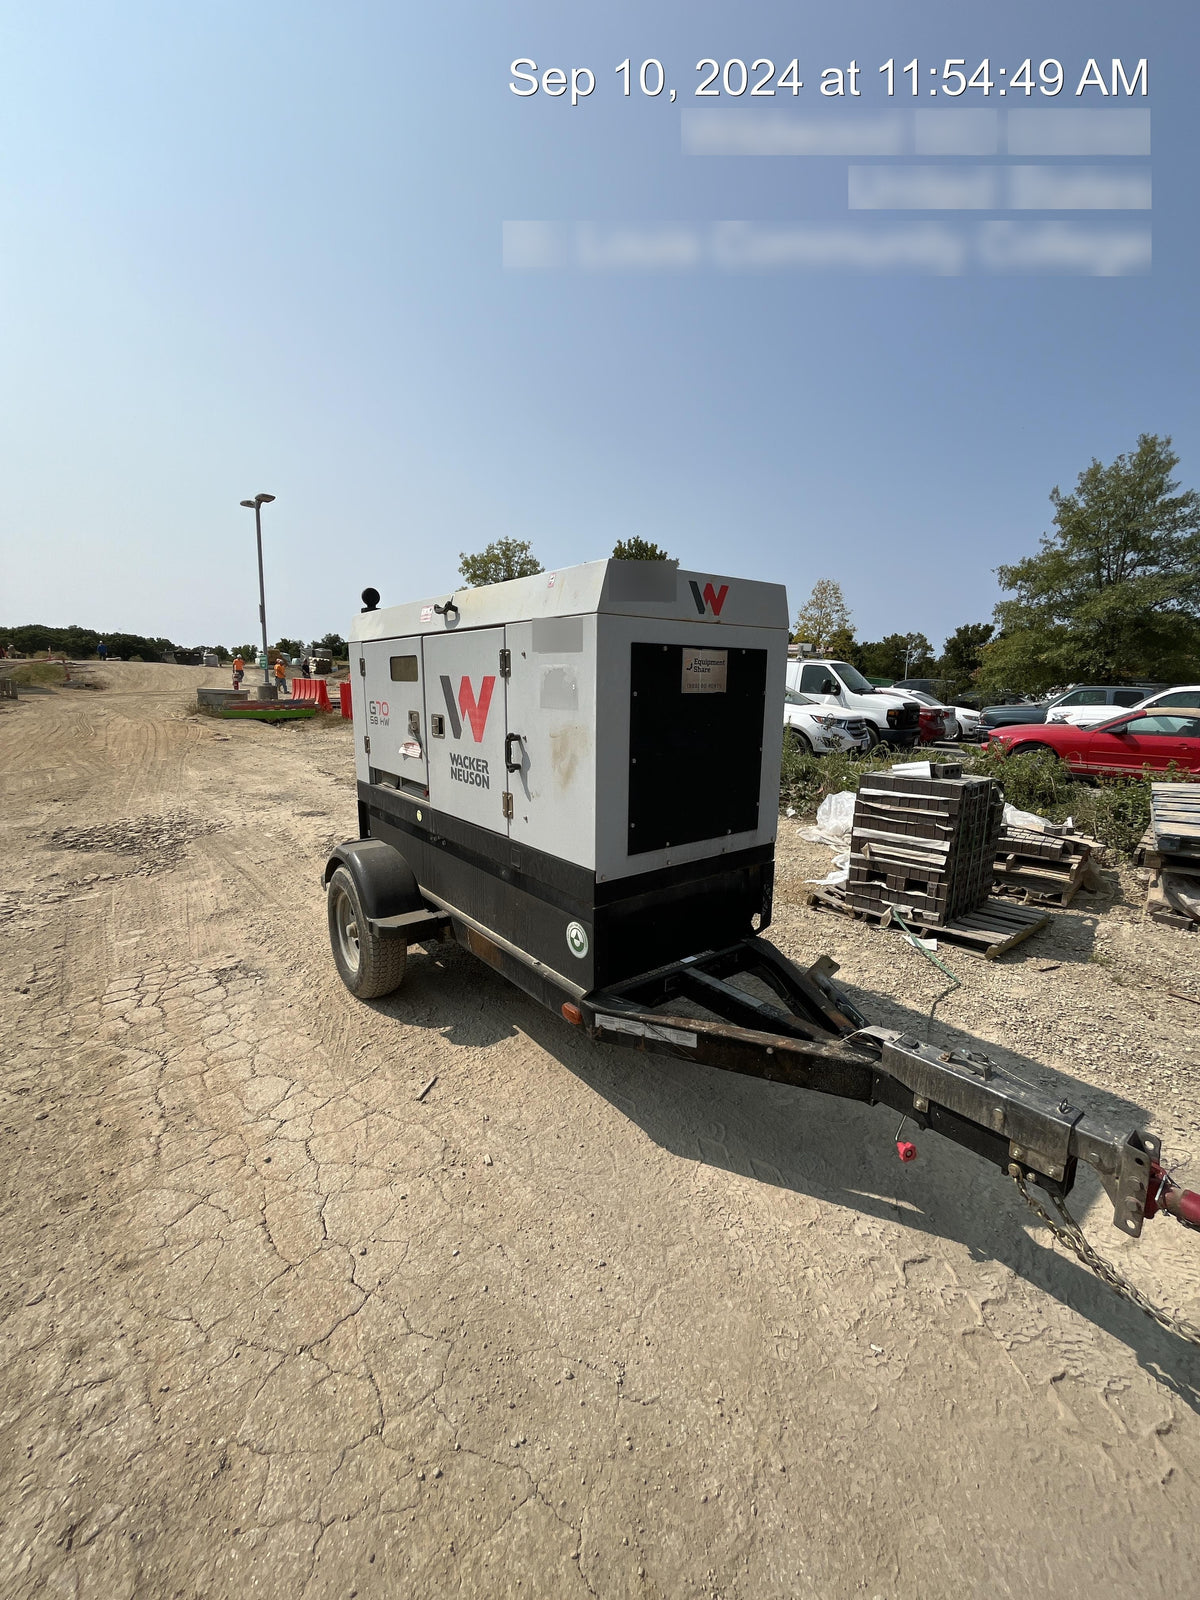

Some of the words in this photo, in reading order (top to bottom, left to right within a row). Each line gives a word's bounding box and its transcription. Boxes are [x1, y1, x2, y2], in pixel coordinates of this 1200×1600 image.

[693, 658, 726, 667] Equipment
[693, 665, 712, 673] Share
[369, 700, 390, 717] G70
[449, 752, 489, 775] WACKER
[450, 765, 490, 790] NEUSON
